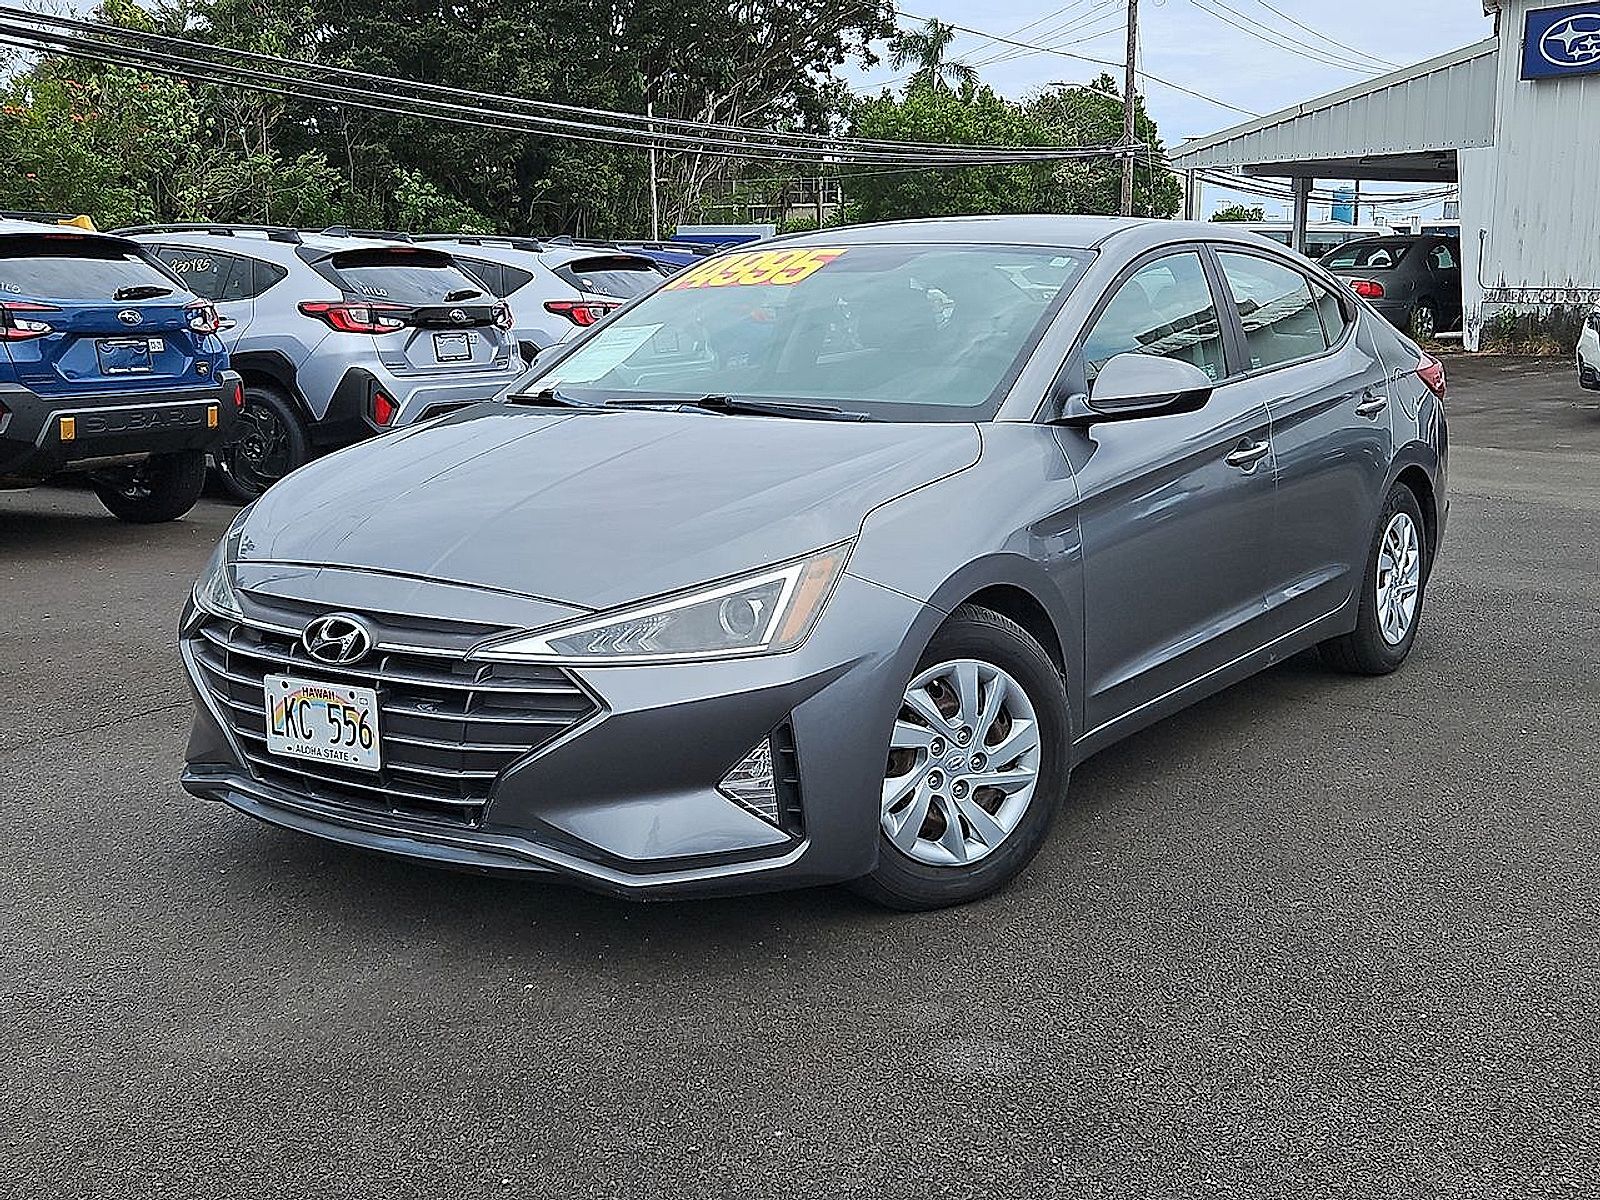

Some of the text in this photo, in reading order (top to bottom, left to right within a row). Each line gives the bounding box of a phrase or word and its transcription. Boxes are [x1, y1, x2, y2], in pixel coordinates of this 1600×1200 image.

[86, 408, 202, 433] SUBARU
[302, 686, 335, 701] HAWAII
[270, 694, 373, 750] LKC 556
[295, 744, 349, 761] ALOHA STATE
